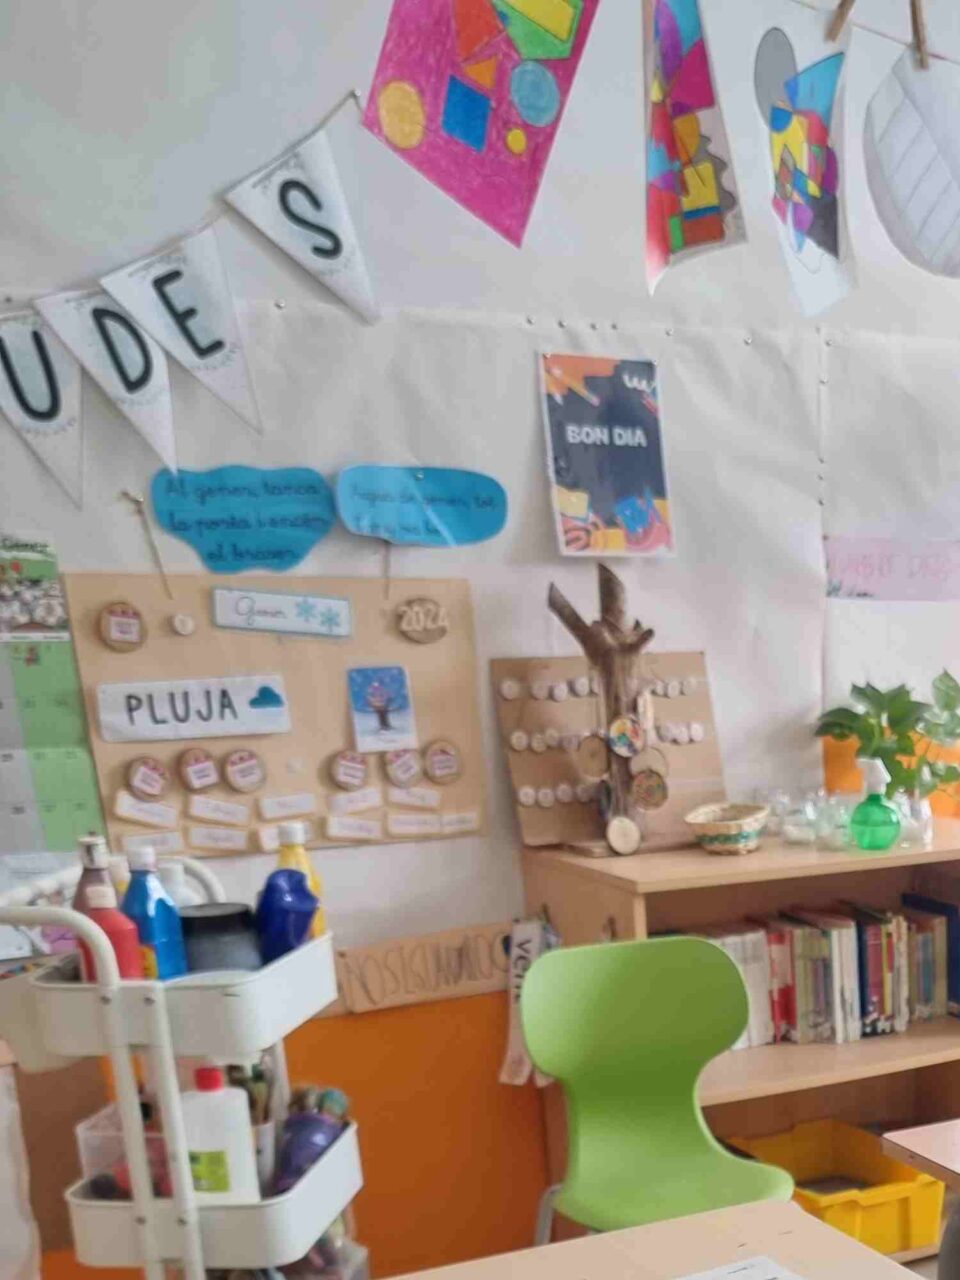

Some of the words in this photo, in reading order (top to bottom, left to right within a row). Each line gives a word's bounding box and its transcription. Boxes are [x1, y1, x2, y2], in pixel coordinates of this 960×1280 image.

[0, 330, 61, 422] U
[93, 308, 152, 394] D
[152, 269, 225, 360] E
[278, 178, 343, 260] S
[566, 426, 609, 445] BON
[614, 427, 647, 446] DIA
[400, 605, 448, 632] 2024
[125, 689, 238, 725] PLUJA
